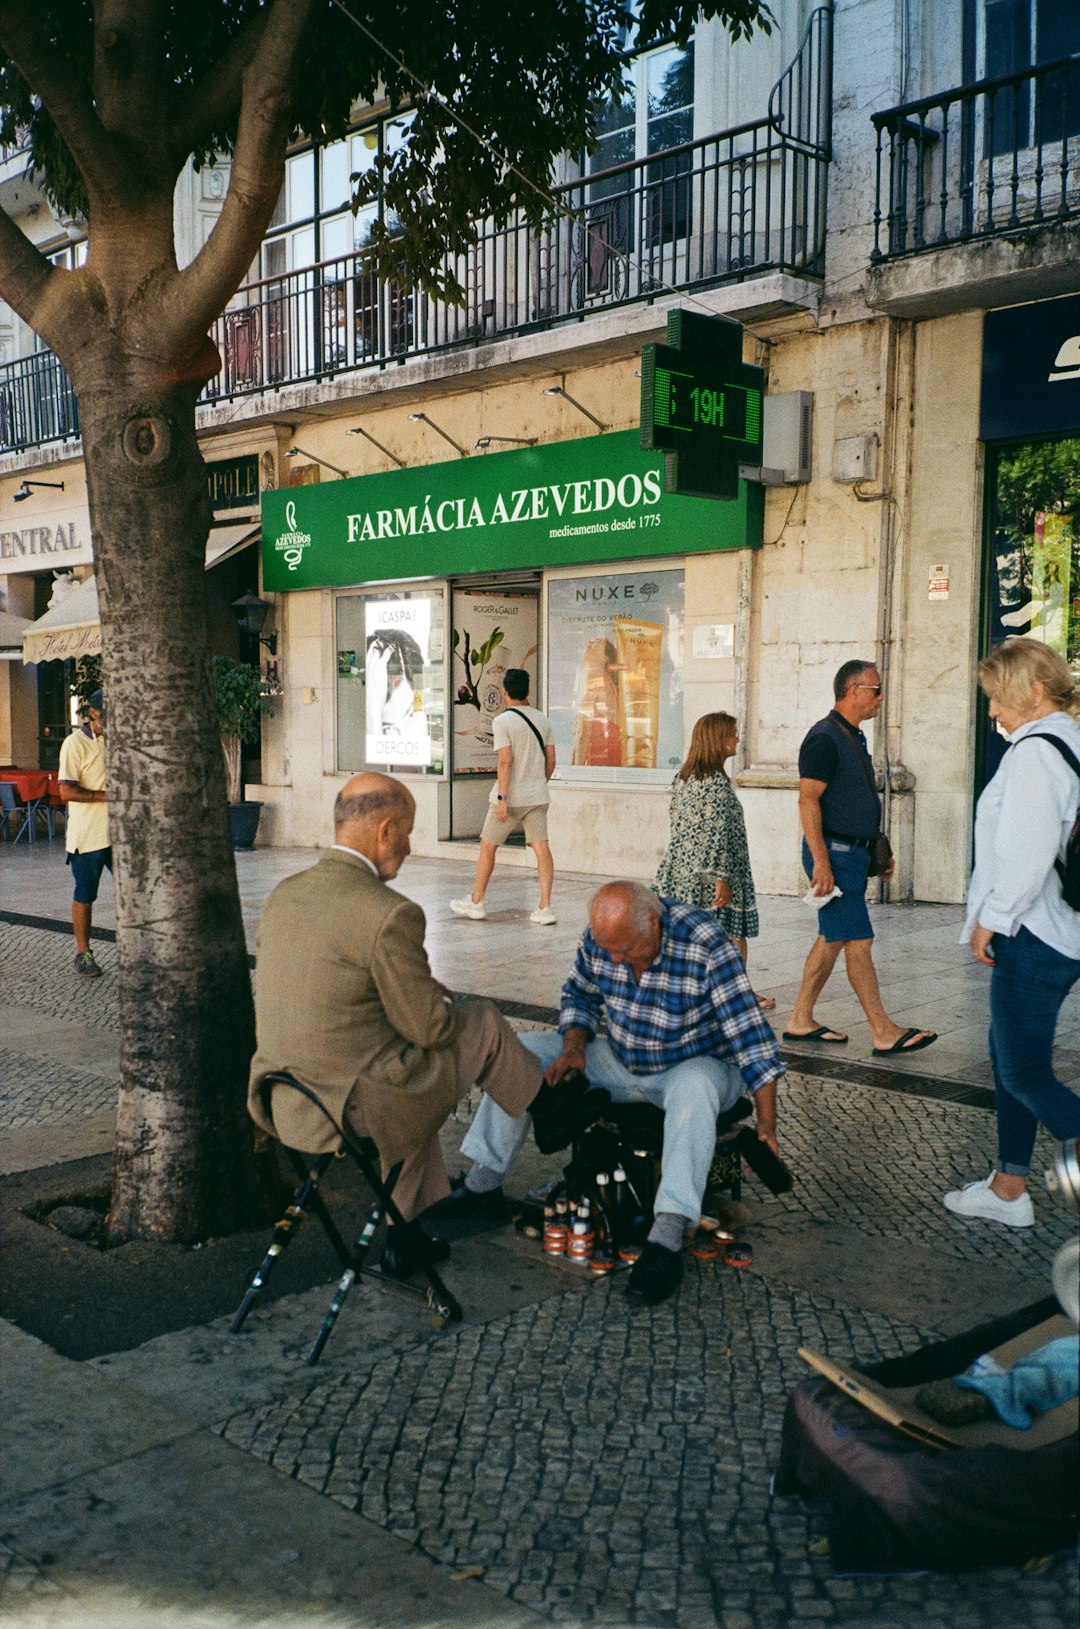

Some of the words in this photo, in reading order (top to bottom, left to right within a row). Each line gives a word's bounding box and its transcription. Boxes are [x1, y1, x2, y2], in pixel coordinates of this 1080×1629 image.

[690, 388, 724, 427] 19H
[346, 495, 485, 543] FARMÁCIA
[489, 470, 661, 525] AZEVEDOS
[549, 523, 609, 538] medicamentos
[611, 516, 636, 532] desde
[639, 513, 661, 528] 1775
[0, 522, 81, 558] ENTRAL
[275, 534, 311, 546] AZEVEDOS
[576, 585, 635, 601] NUXE
[40, 631, 73, 656] Hotel
[376, 740, 420, 755] DERCOS
